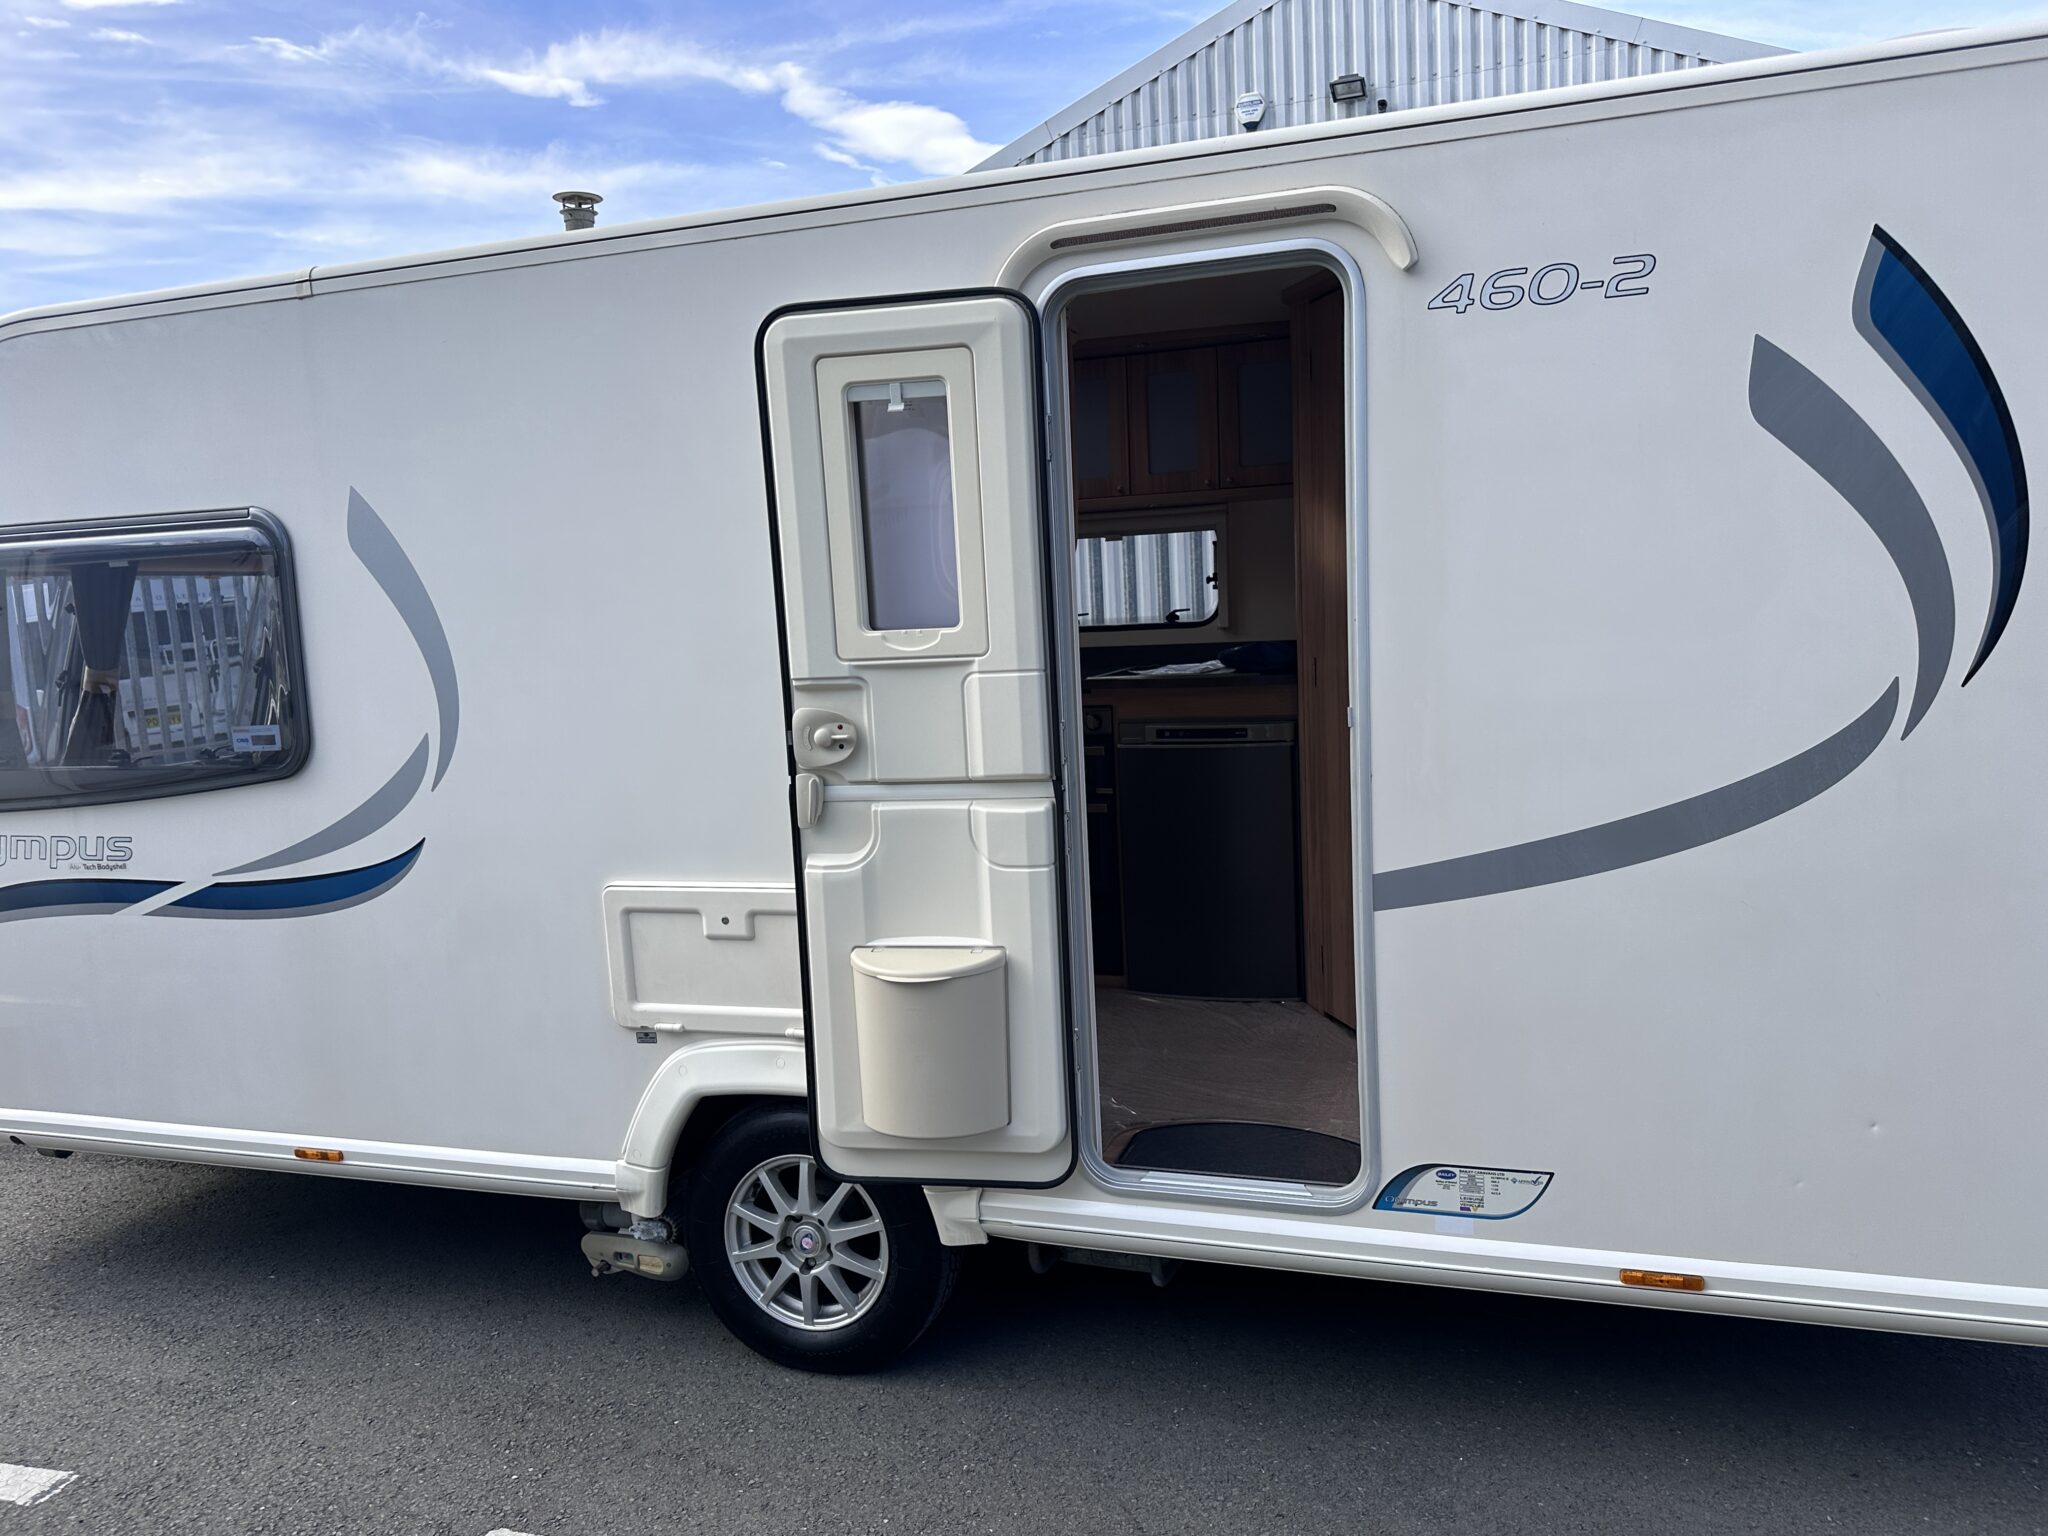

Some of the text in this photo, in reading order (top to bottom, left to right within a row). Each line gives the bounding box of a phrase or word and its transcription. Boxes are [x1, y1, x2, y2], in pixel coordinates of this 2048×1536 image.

[1427, 253, 1657, 314] 460-2
[83, 863, 97, 871] Tech
[97, 863, 127, 872] Bodyshell
